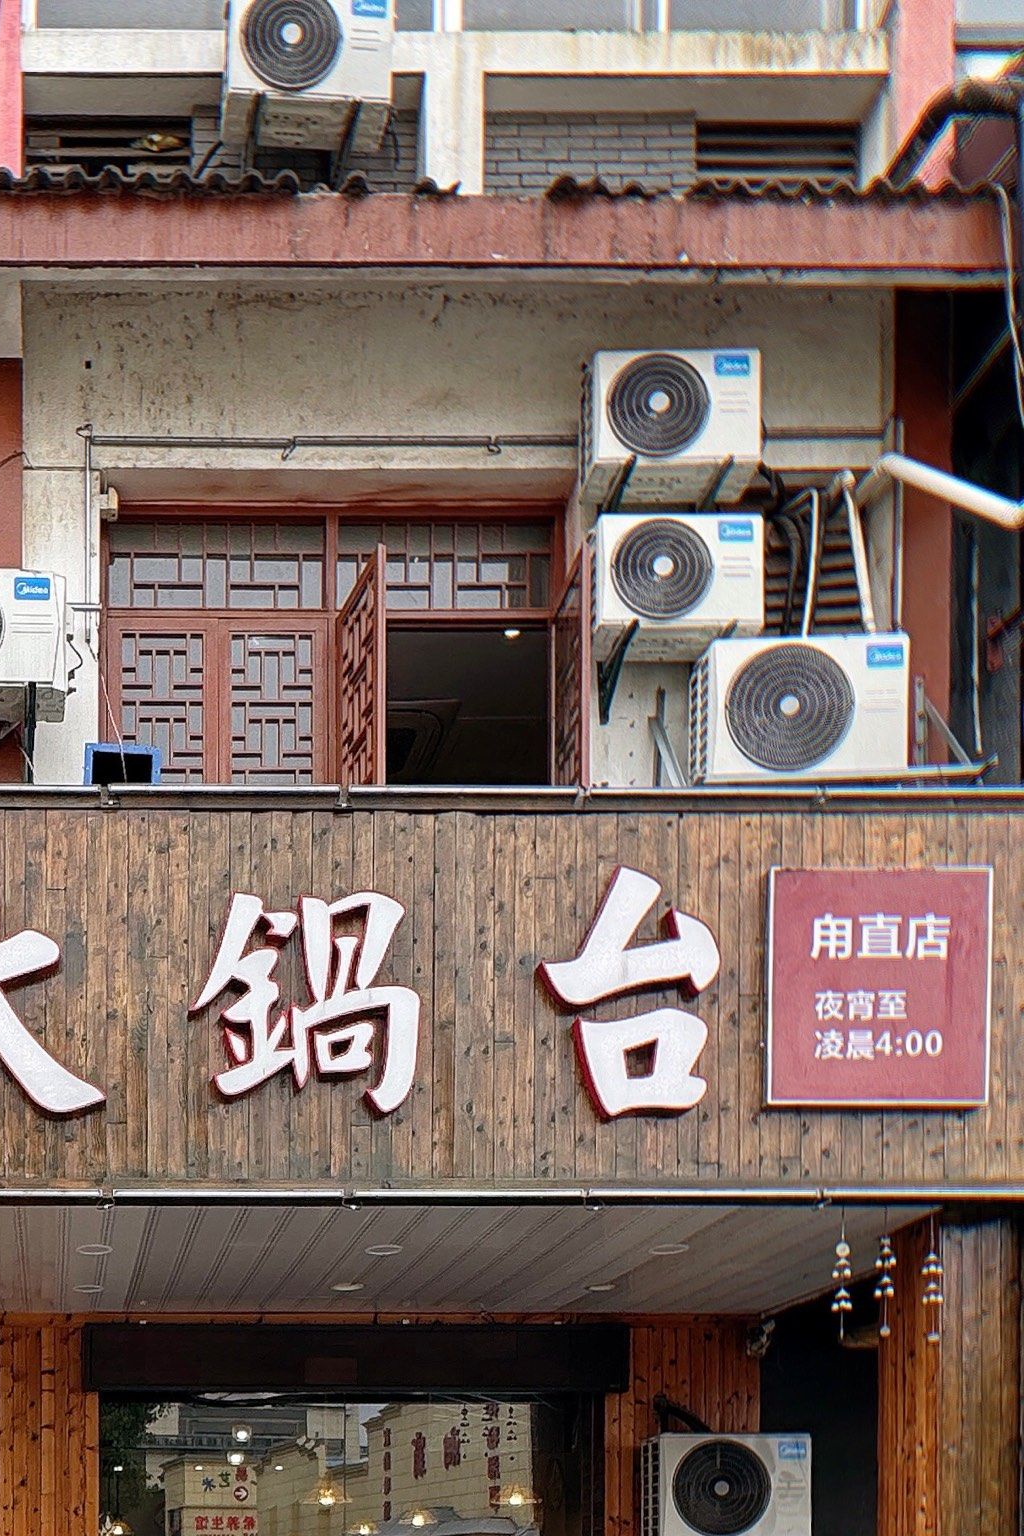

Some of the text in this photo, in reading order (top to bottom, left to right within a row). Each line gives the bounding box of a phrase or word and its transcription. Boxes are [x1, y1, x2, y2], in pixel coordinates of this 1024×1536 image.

[16, 582, 49, 595] Midea
[814, 989, 908, 1022] 夜宵至
[814, 1029, 944, 1061] 凌晨4:00
